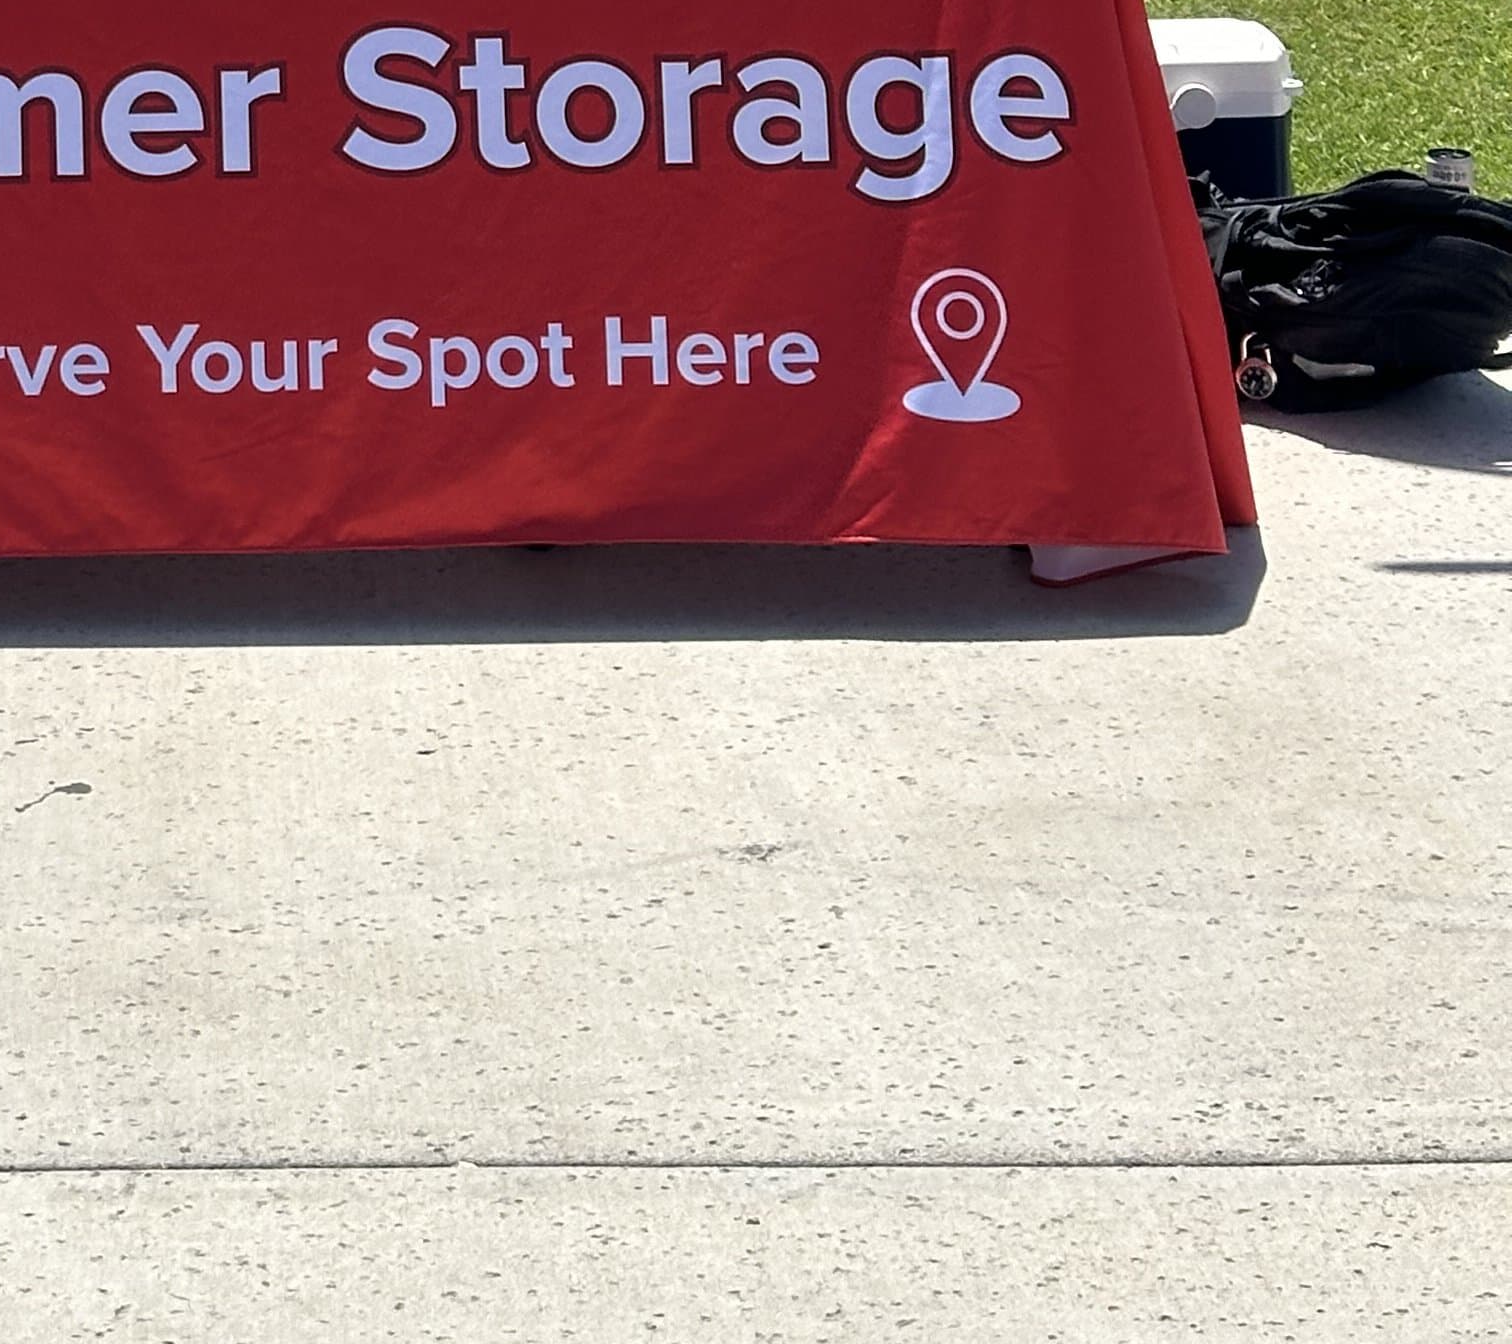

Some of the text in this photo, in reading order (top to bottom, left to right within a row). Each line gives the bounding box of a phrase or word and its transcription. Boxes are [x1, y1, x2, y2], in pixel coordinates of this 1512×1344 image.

[342, 27, 1071, 201] Storage
[136, 323, 338, 393] Your
[367, 318, 575, 407] Spot
[604, 315, 820, 386] Here
